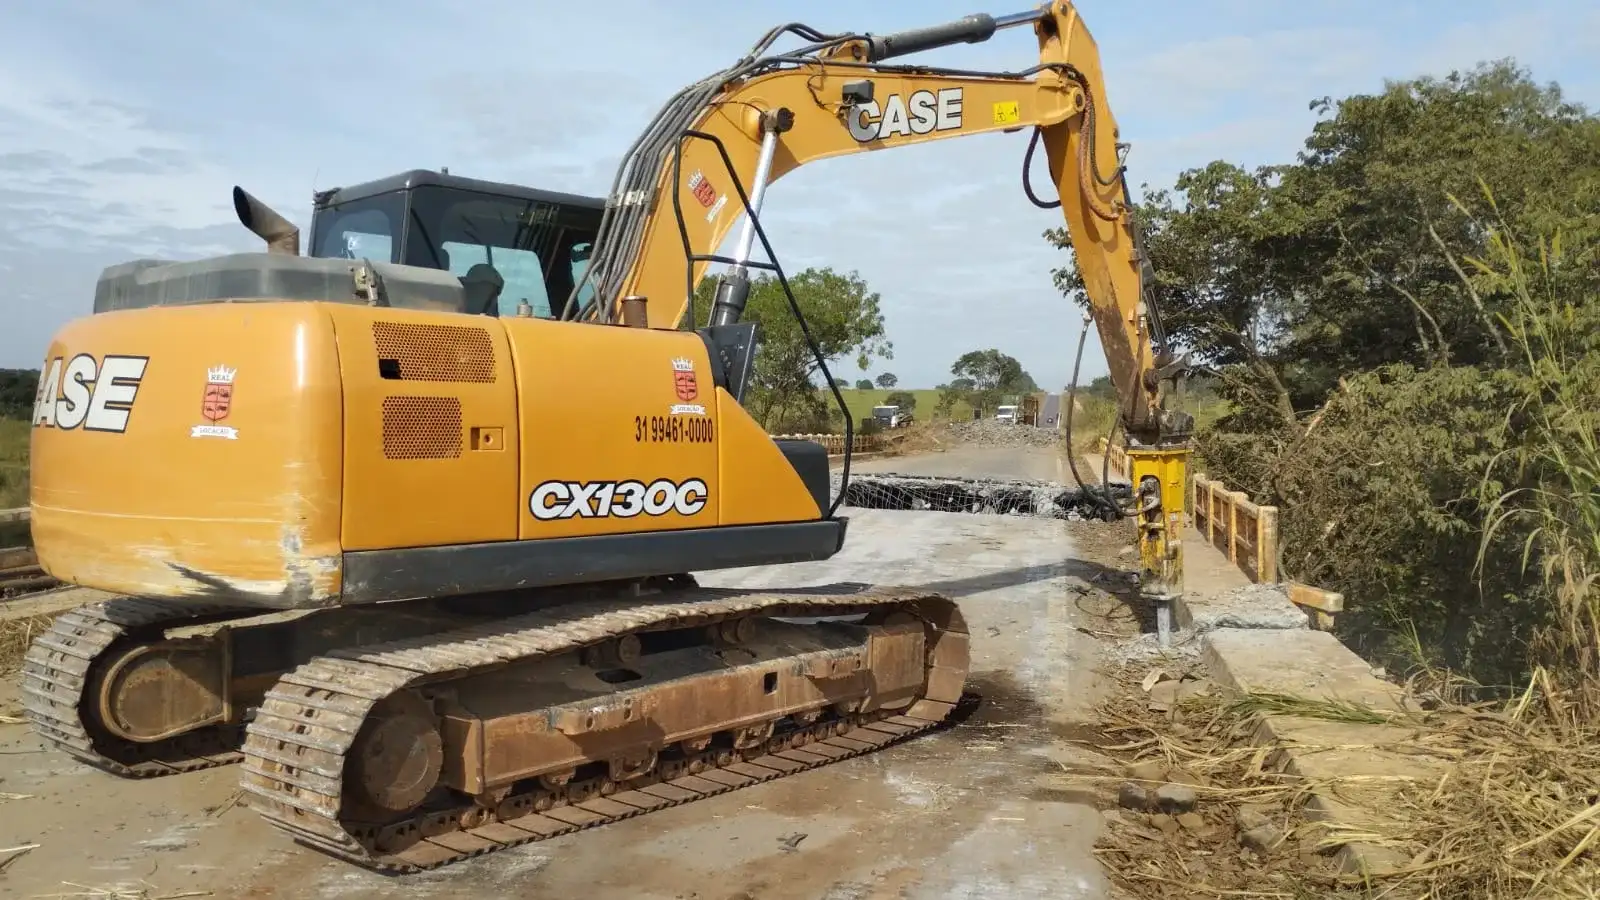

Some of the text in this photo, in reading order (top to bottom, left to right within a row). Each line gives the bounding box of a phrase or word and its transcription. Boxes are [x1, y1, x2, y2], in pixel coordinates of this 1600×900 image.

[849, 87, 963, 142] CASE
[32, 353, 150, 433] ASE
[635, 415, 713, 442] 31 99461-0000
[529, 477, 708, 521] CX130C
